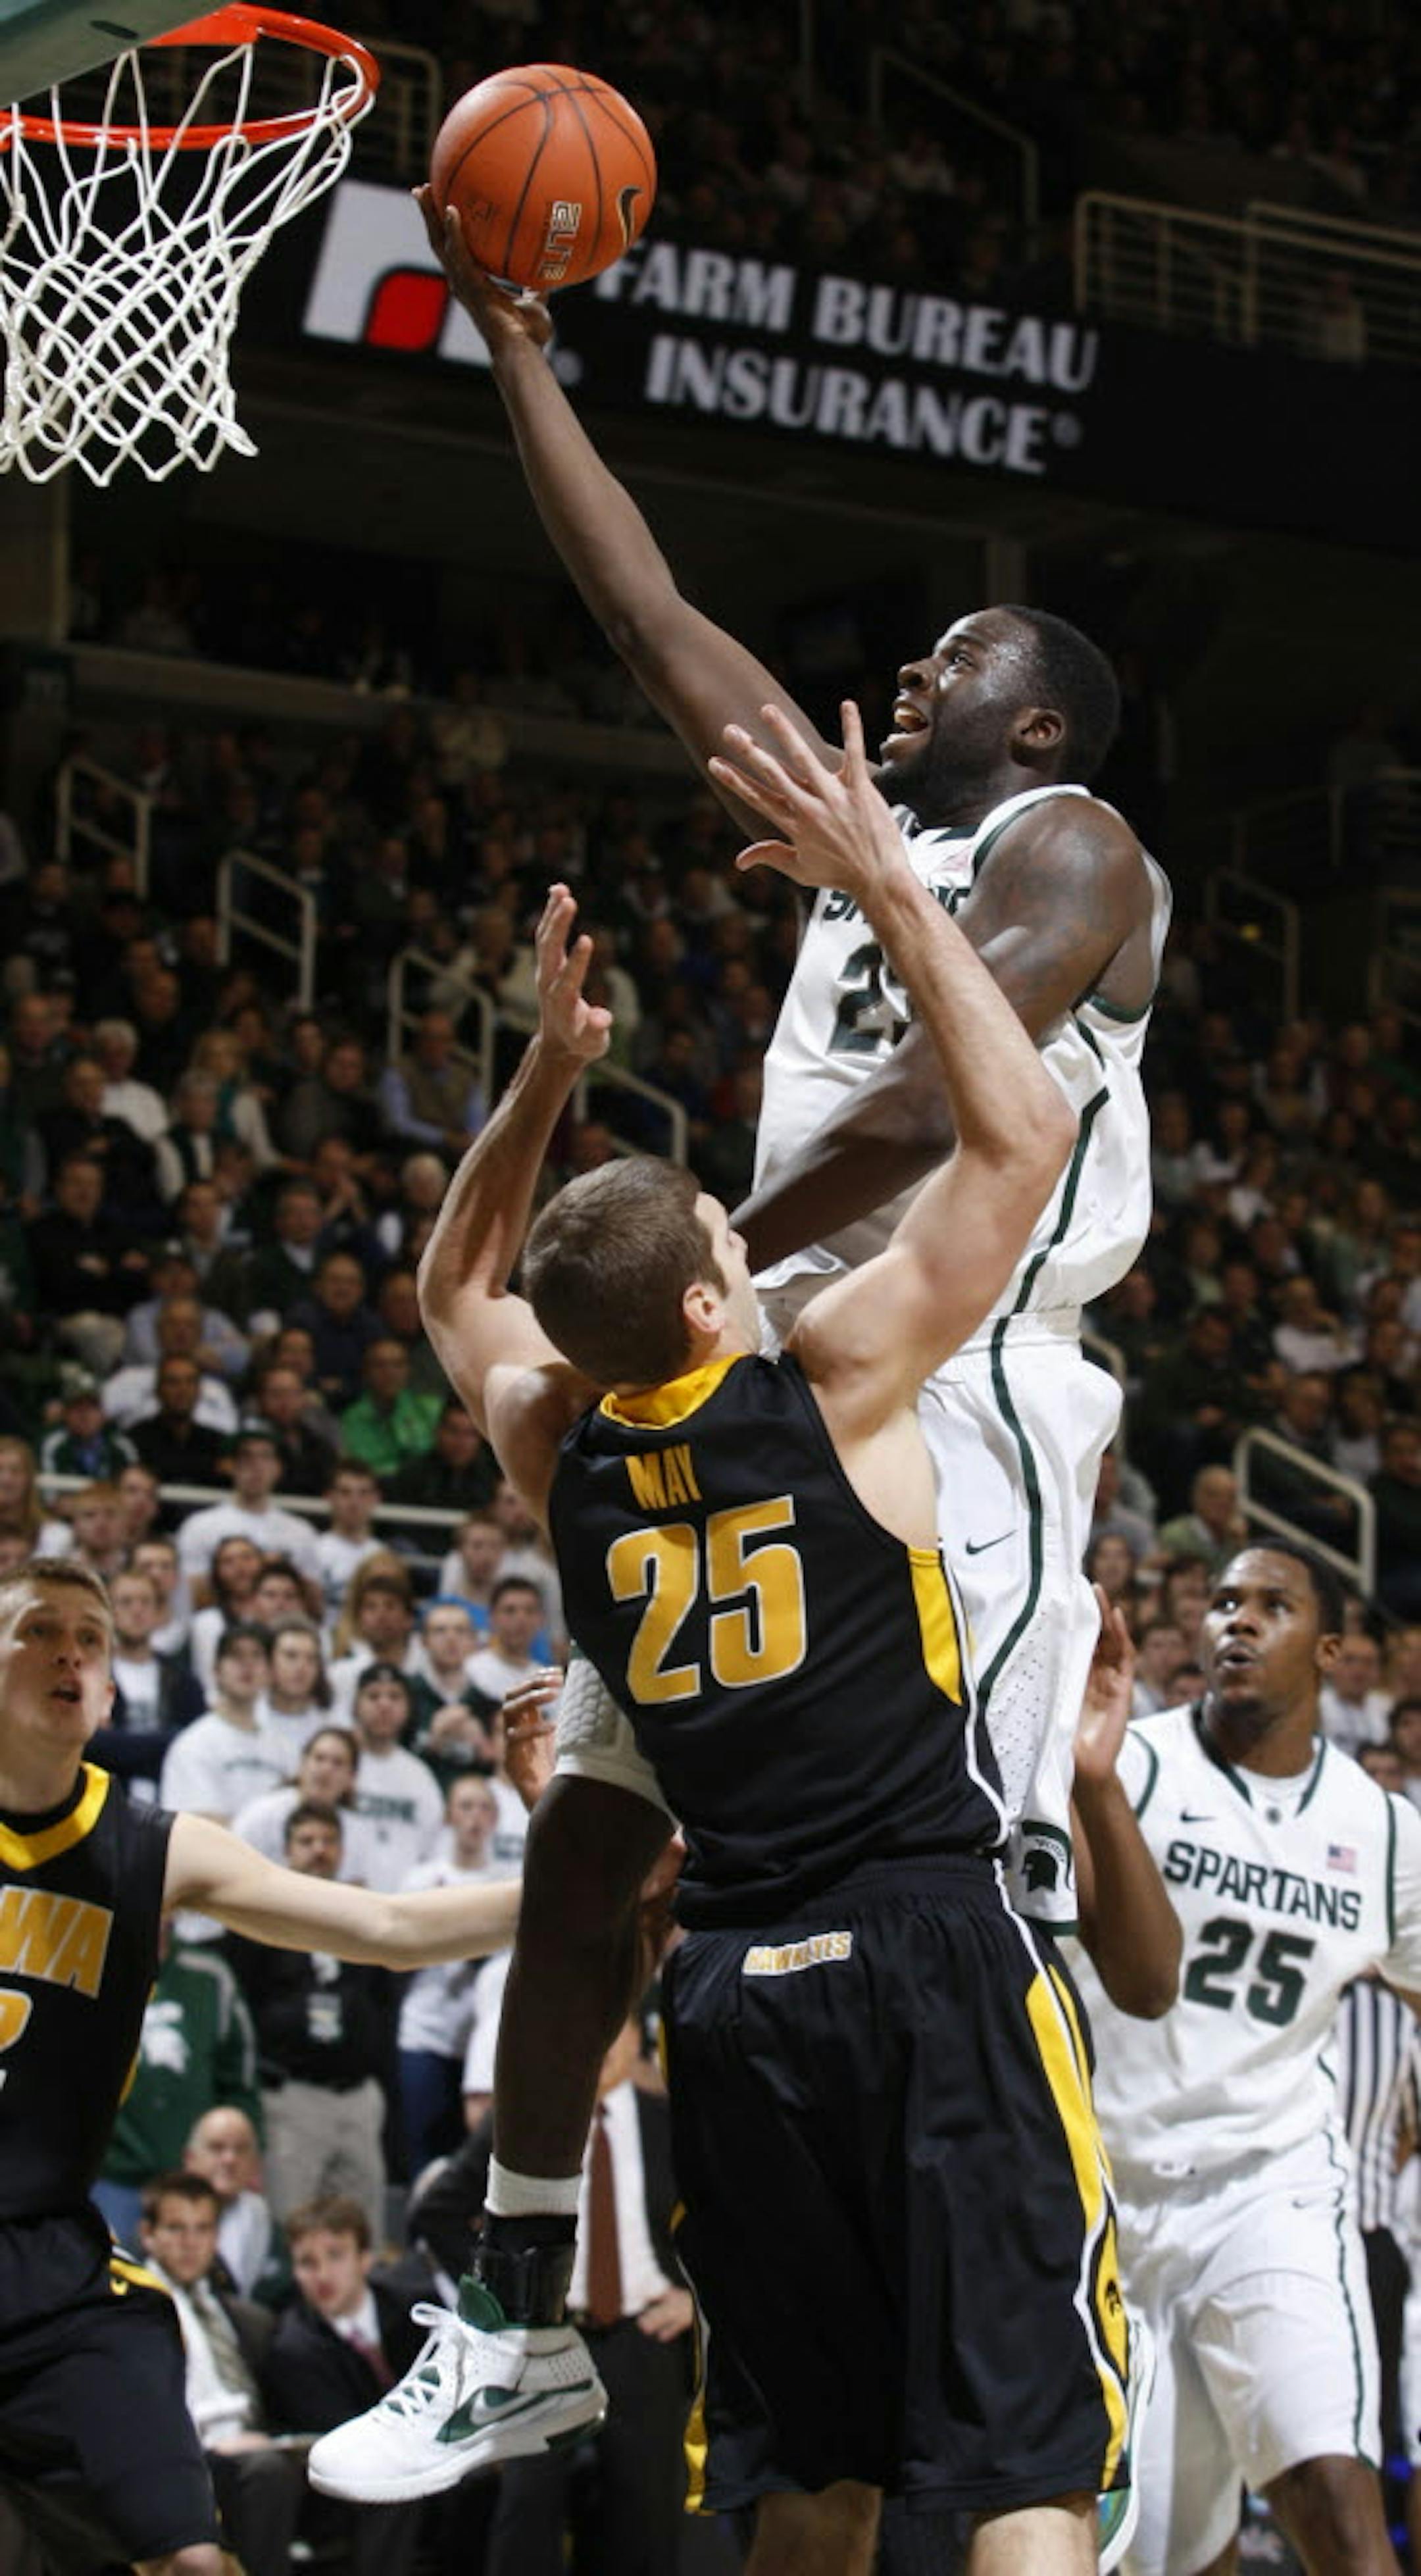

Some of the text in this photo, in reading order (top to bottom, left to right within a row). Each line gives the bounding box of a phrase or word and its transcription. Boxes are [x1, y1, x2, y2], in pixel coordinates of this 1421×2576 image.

[595, 242, 1097, 391] FARM BUREAU
[645, 334, 1047, 473] INSURANCE
[625, 1444, 703, 1511] MAY
[606, 1493, 807, 1705] 25
[1163, 1840, 1361, 1931] SPARTANS
[1183, 1915, 1315, 2027] 25
